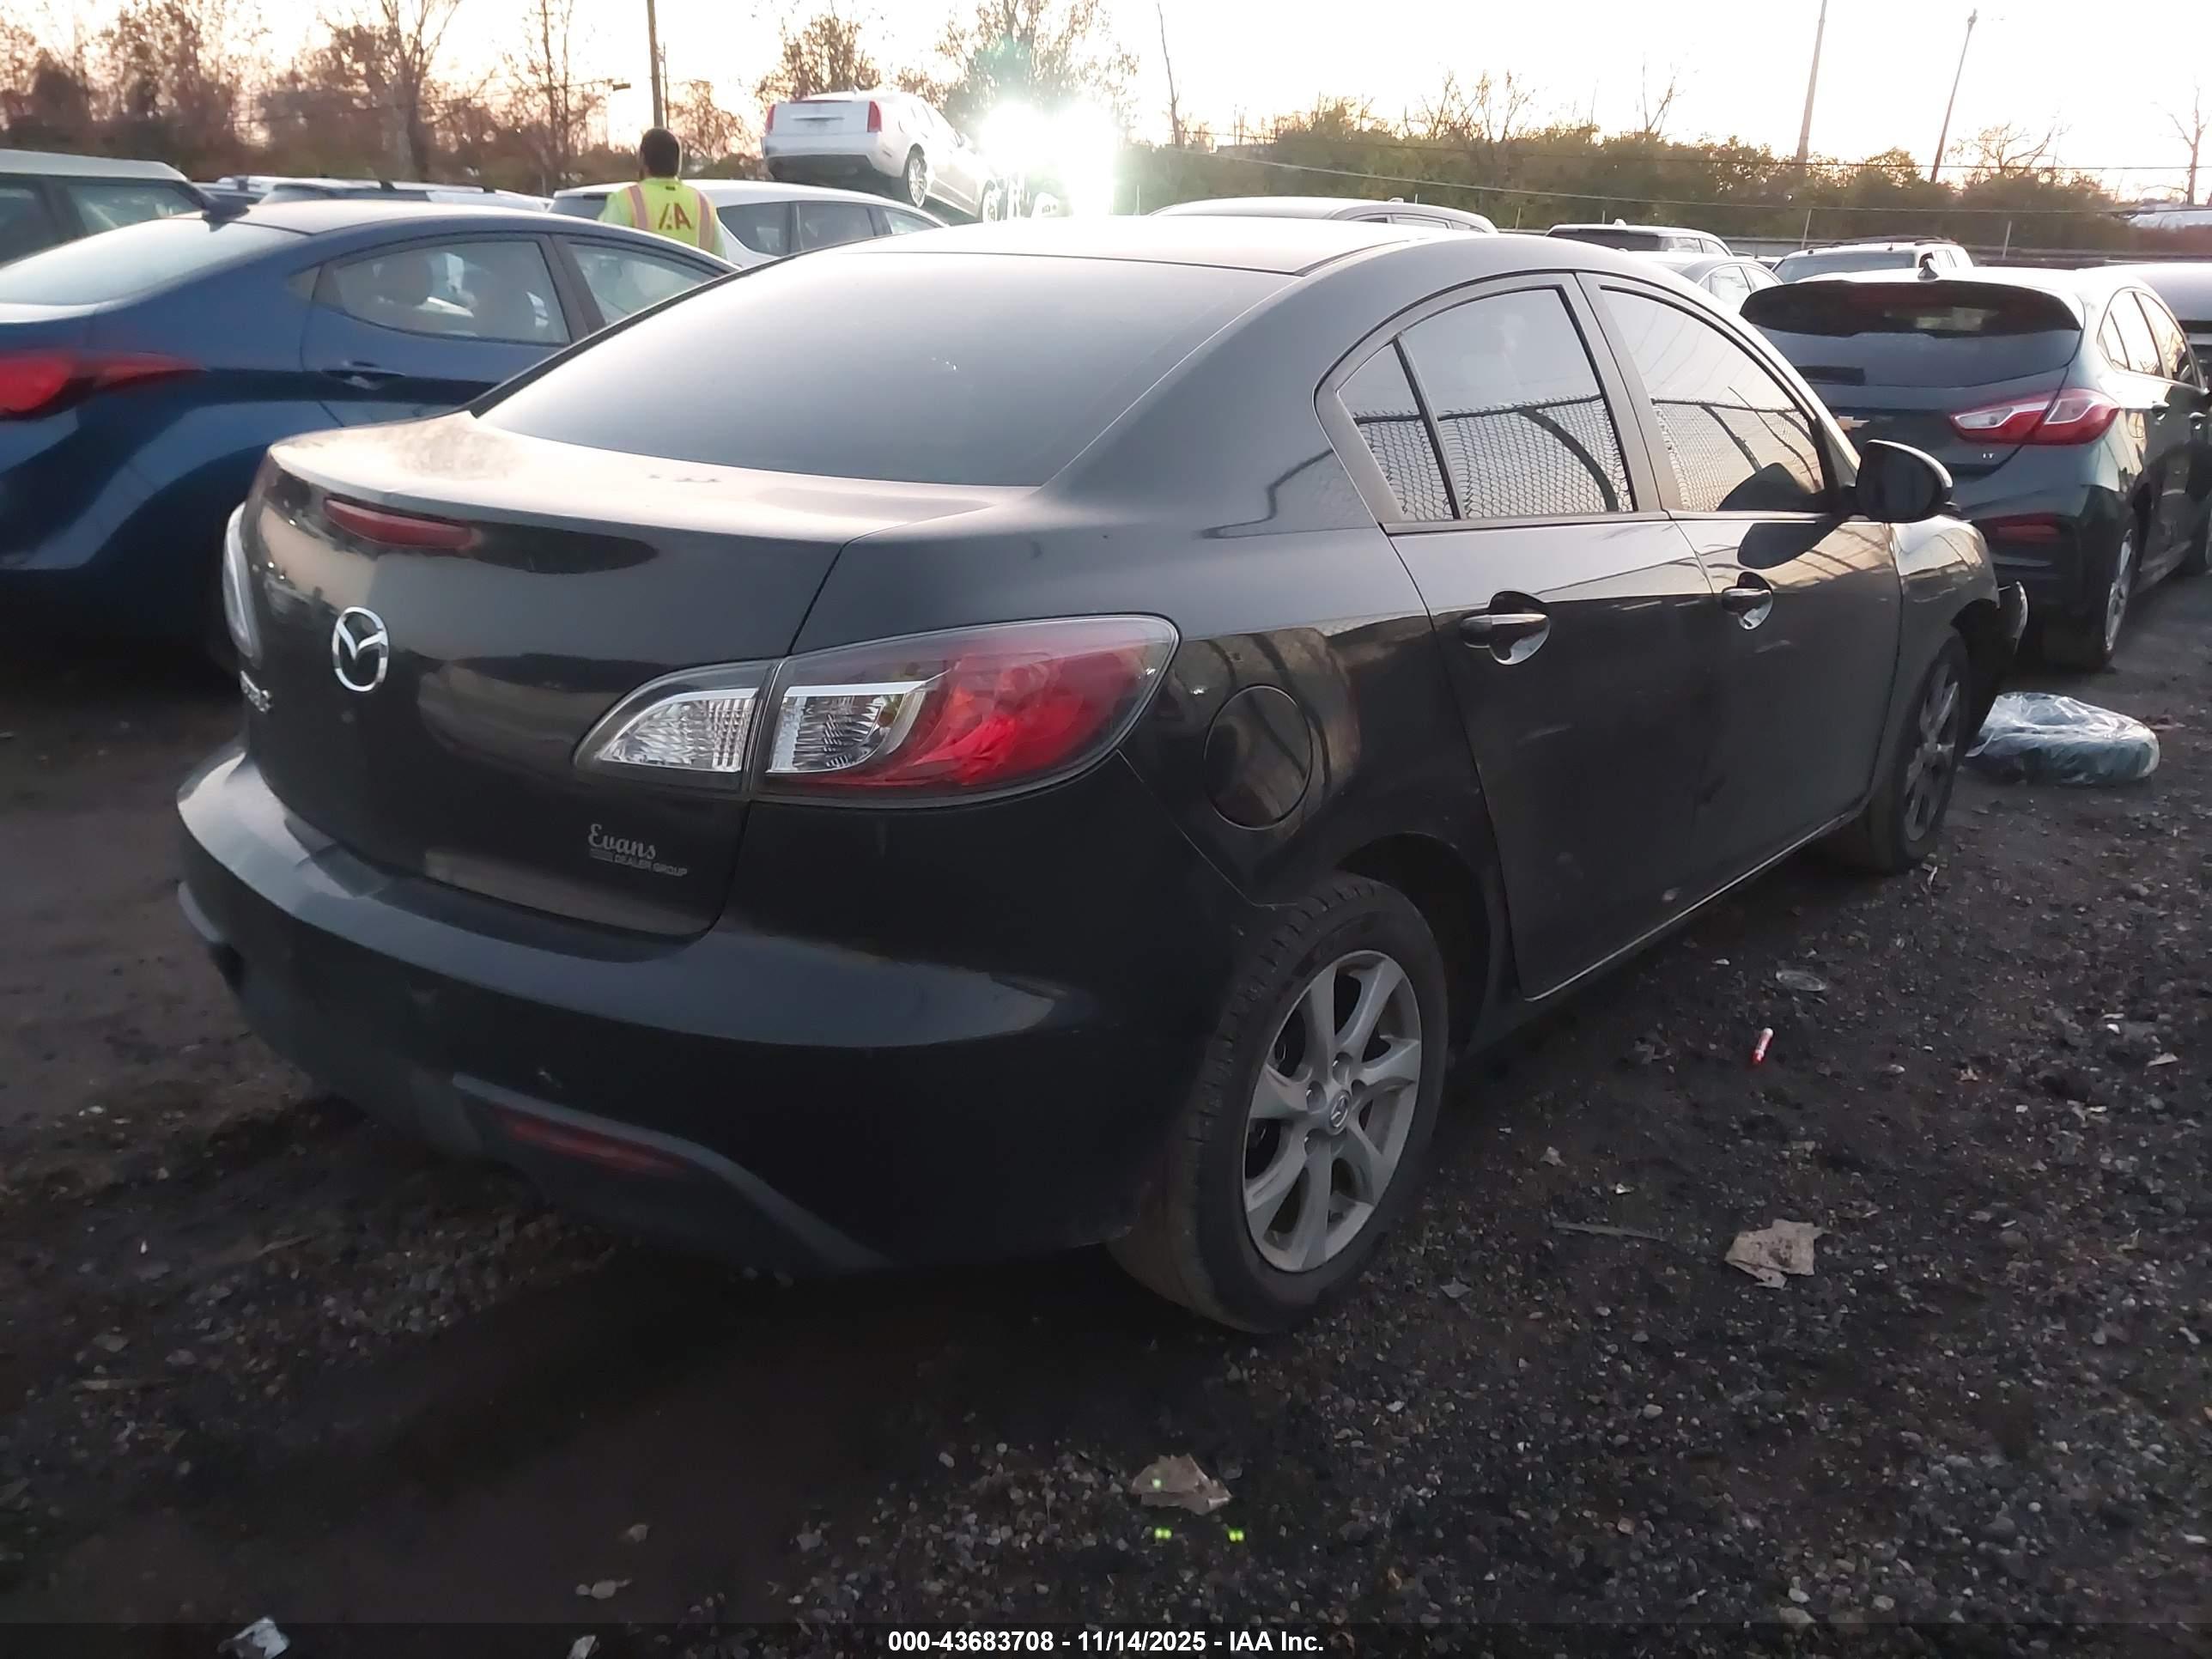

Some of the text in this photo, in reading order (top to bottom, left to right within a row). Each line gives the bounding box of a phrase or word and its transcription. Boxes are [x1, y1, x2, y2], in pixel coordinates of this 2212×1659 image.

[588, 823, 656, 860] Evans
[614, 854, 688, 878] DEALER GROUP
